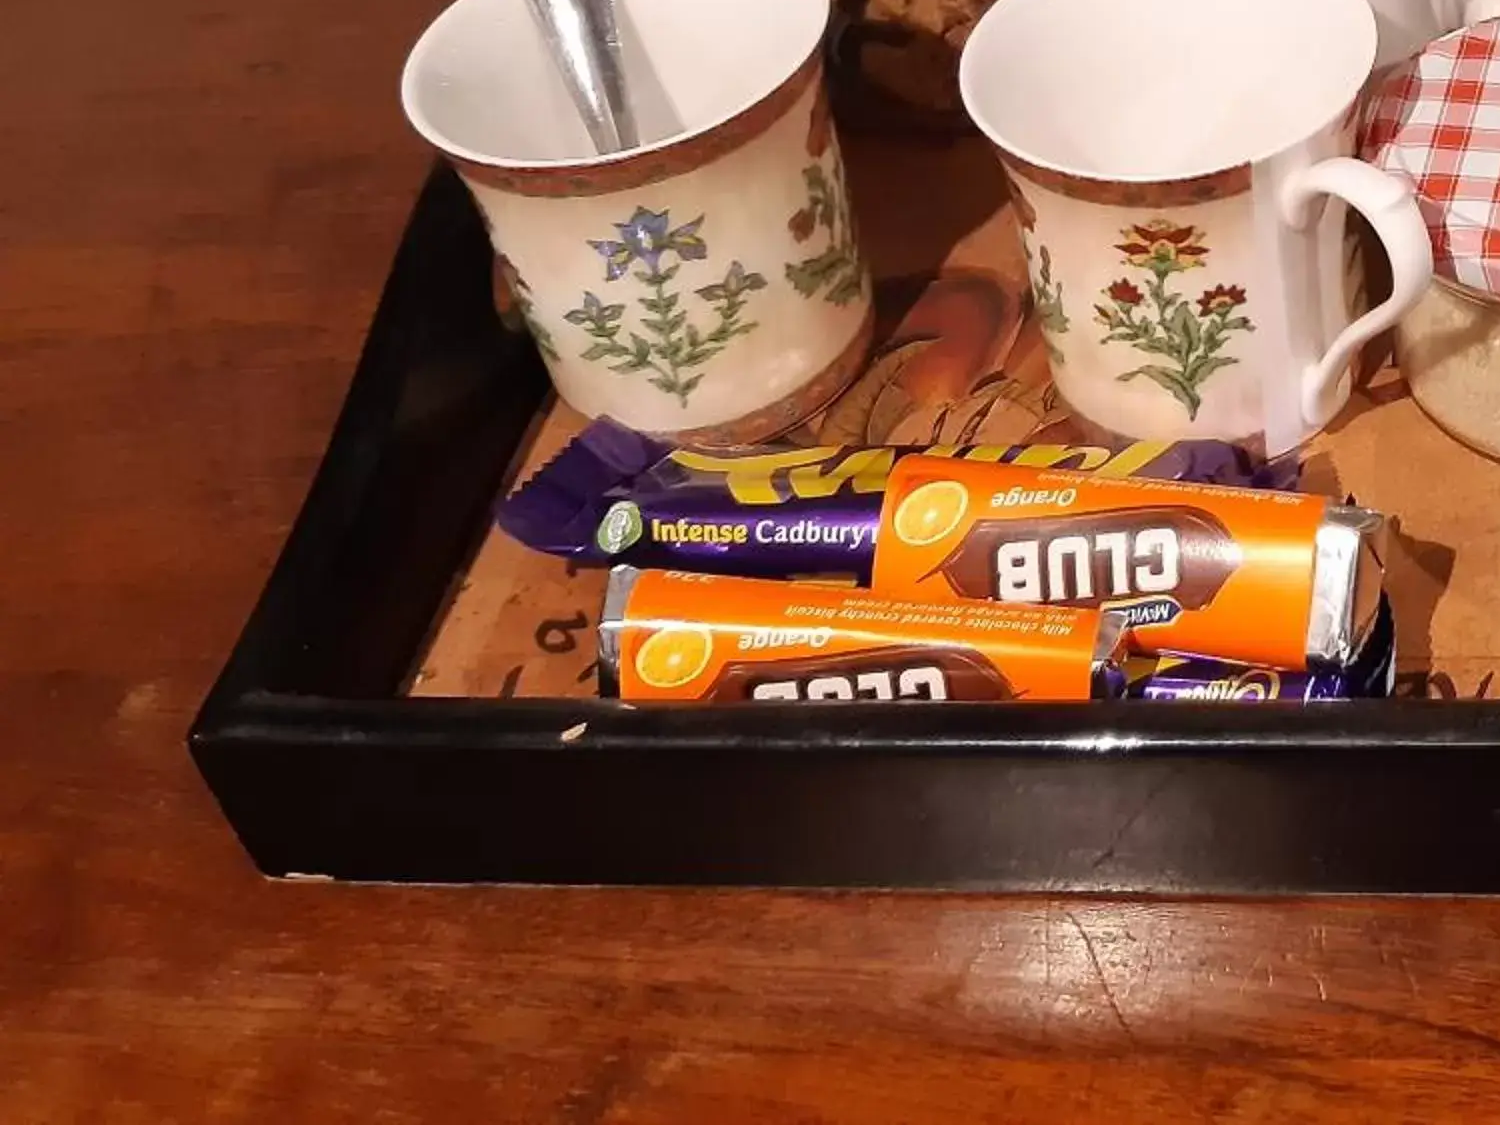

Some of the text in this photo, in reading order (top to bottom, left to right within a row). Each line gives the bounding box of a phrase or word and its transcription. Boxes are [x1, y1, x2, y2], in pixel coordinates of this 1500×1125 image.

[991, 487, 1077, 509] Orange
[651, 518, 748, 546] Intense
[754, 518, 862, 550] Cadbury
[998, 527, 1179, 601] CLUB
[784, 604, 1073, 635] Milk chocolate covered crunchy biscuit
[738, 625, 833, 650] Orange
